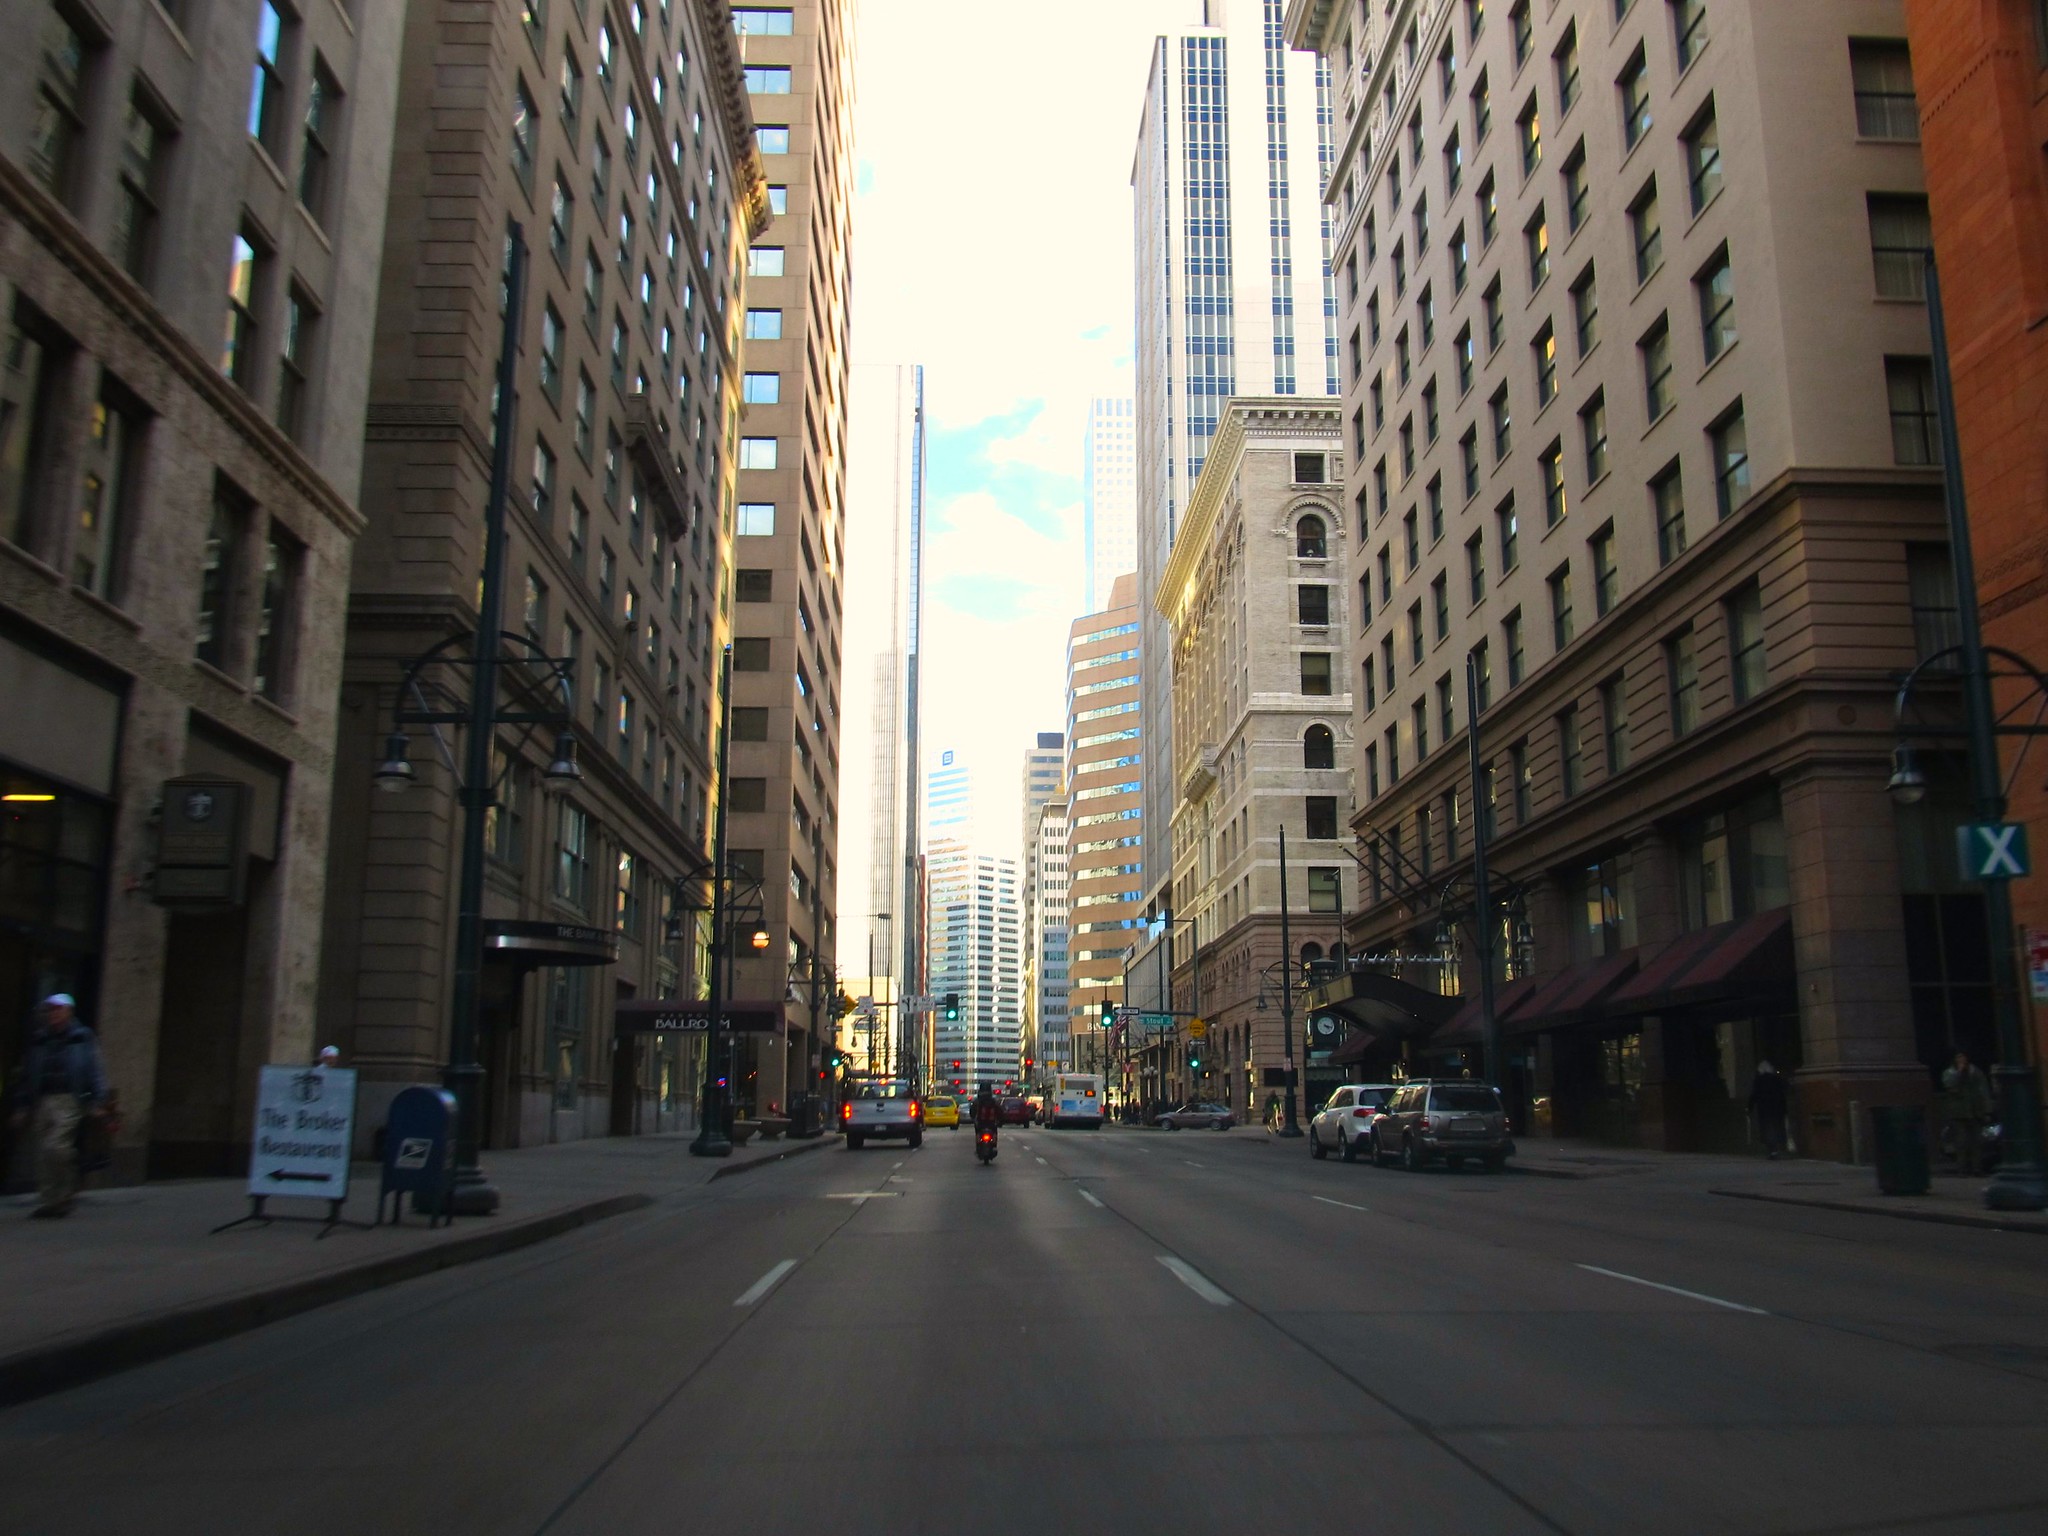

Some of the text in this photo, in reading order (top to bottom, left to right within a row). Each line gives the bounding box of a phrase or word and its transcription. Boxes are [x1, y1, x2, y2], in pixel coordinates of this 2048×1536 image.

[1976, 825, 2025, 875] X
[655, 1018, 731, 1029] BALLROM
[260, 1108, 288, 1130] The
